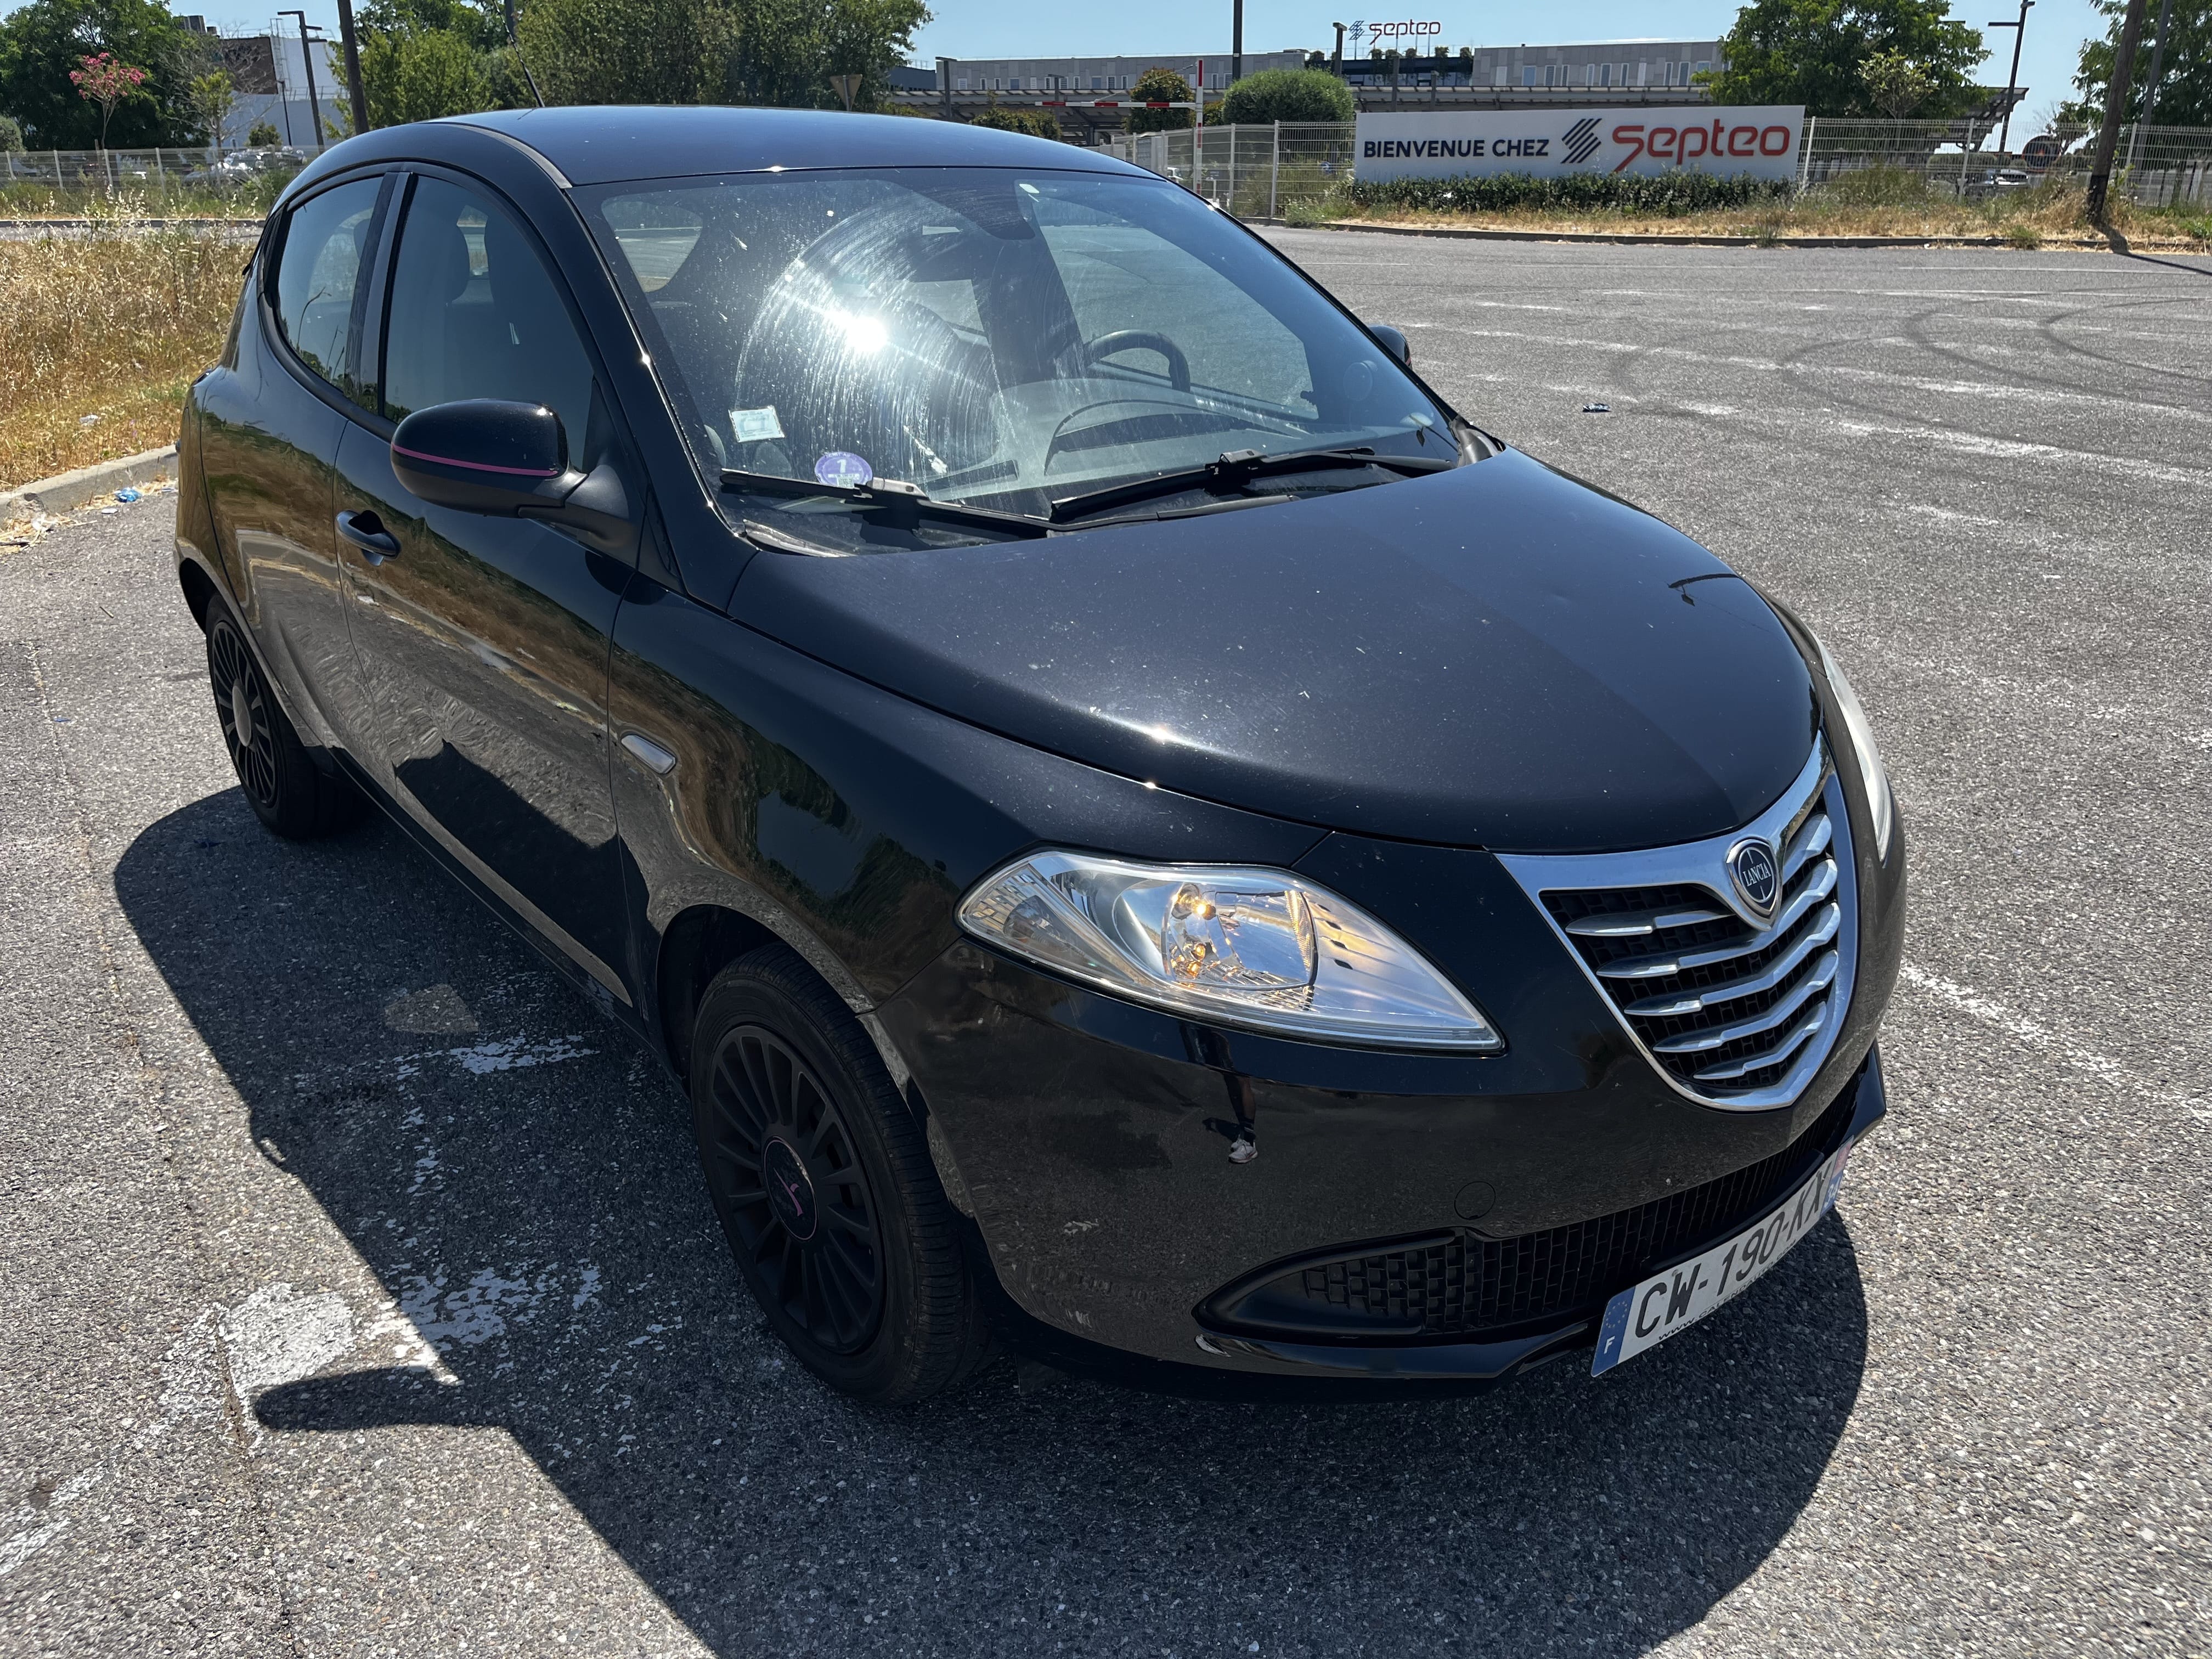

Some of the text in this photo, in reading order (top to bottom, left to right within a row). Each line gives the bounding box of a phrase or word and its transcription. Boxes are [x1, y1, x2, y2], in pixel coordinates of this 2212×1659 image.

[1364, 139, 1485, 159] BIENVENUE
[1492, 138, 1549, 157] CHEZ
[837, 459, 847, 473] 1
[1742, 862, 1771, 887] LANCIA
[1634, 1161, 1832, 1339] CW-190-KX
[1604, 1336, 1616, 1354] F
